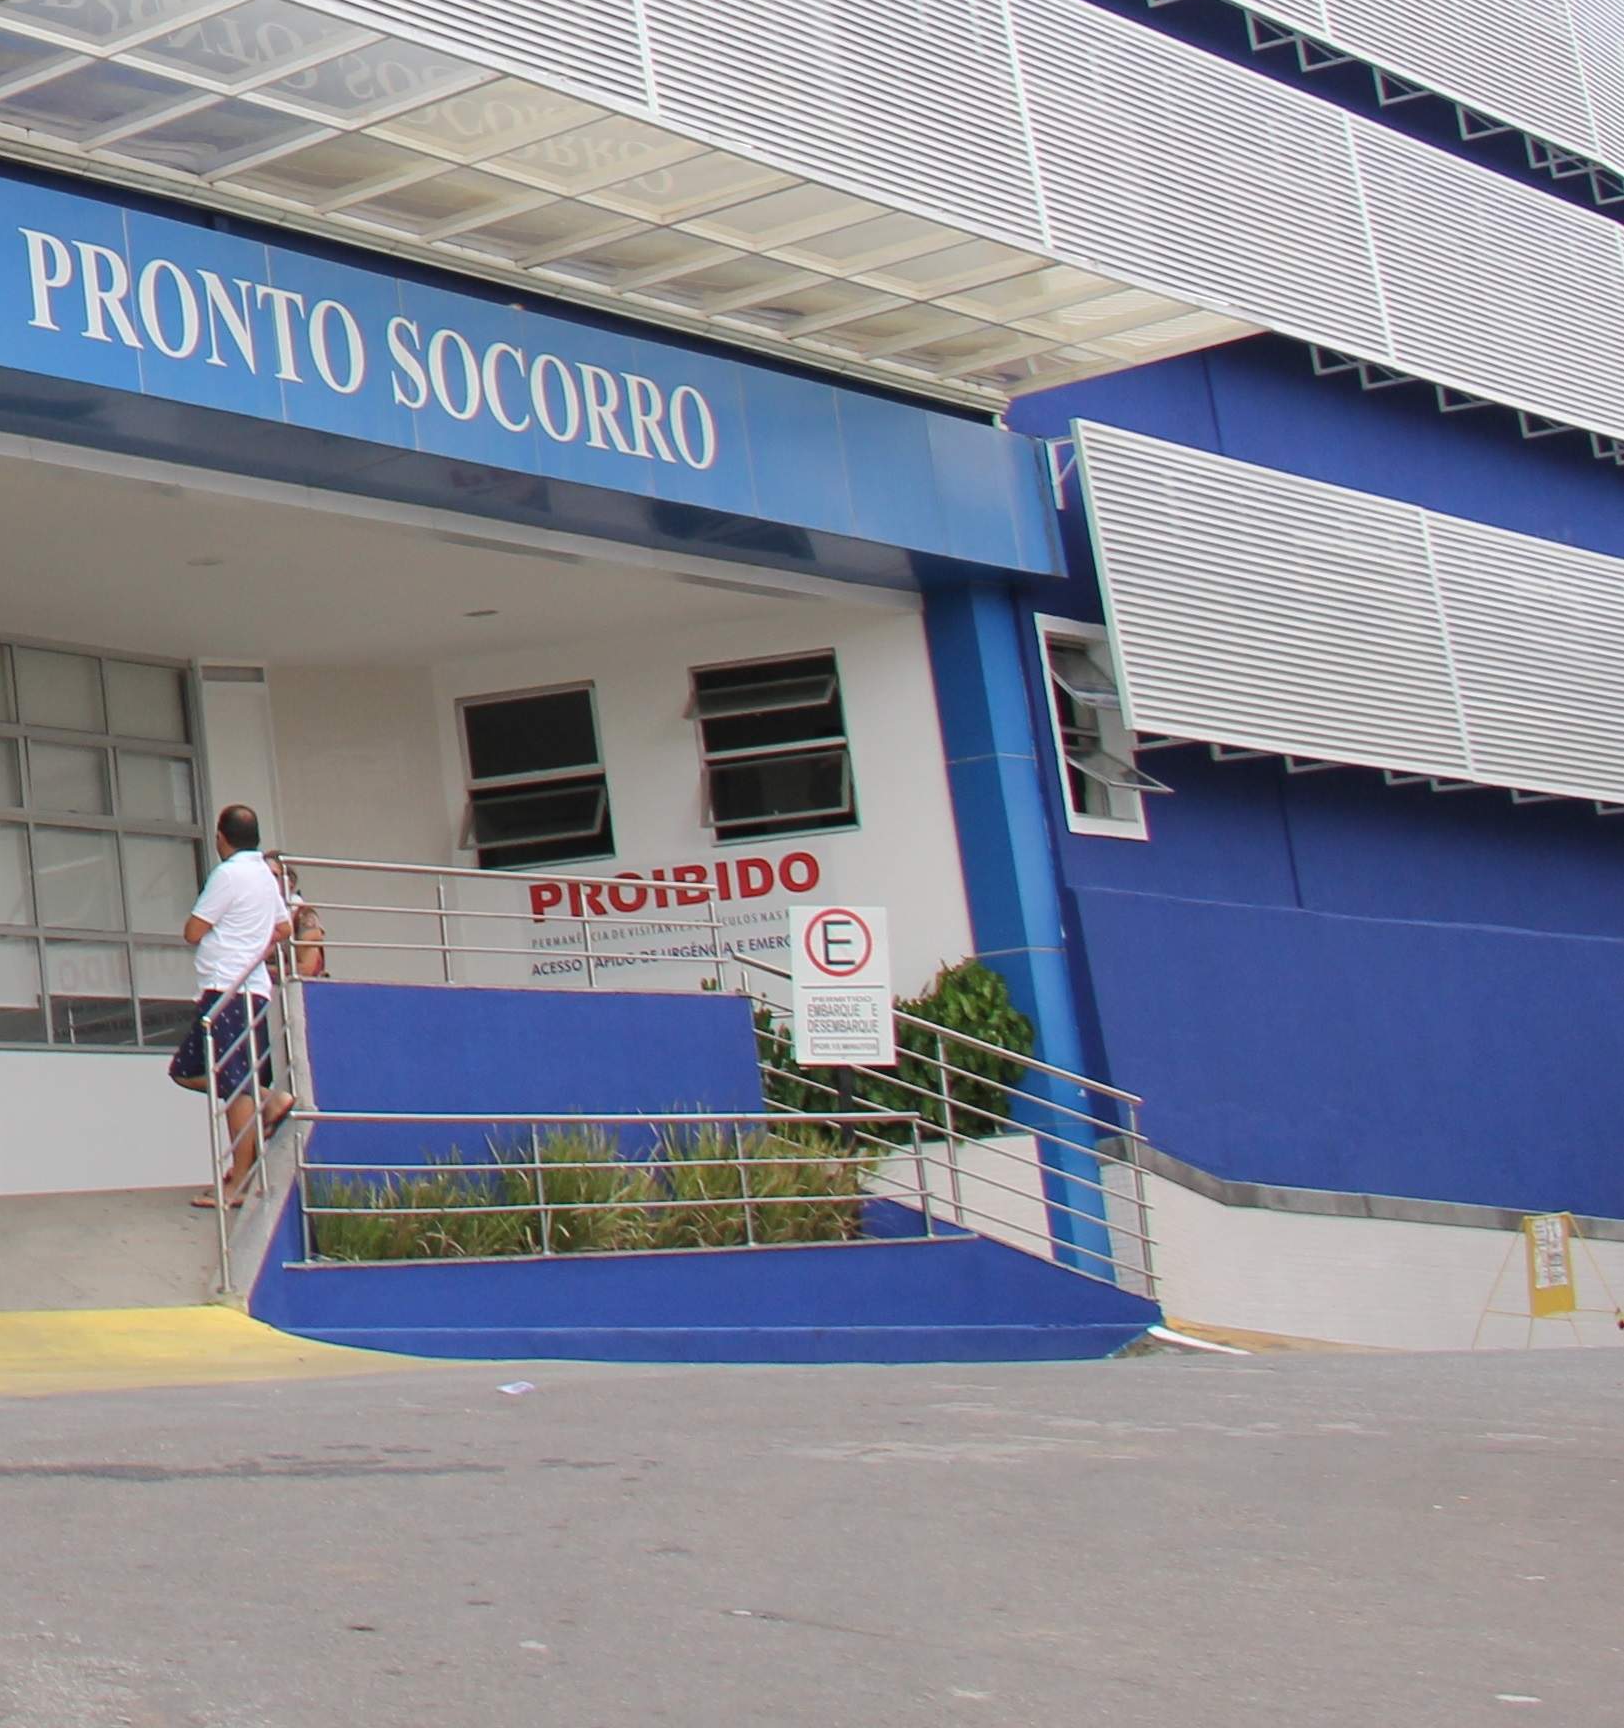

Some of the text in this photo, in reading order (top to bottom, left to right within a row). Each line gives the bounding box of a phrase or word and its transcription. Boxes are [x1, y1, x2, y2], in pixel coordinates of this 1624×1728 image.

[18, 226, 718, 470] PRONTO SOCORRO
[529, 851, 821, 923] PROIBIDO
[531, 928, 611, 949] PERMANÊCIA
[823, 920, 855, 966] E
[531, 958, 583, 977] ACESSO
[736, 939, 745, 952] E
[807, 1003, 878, 1017] EMBARQUE E
[807, 1019, 879, 1033] DESEMBARQUE
